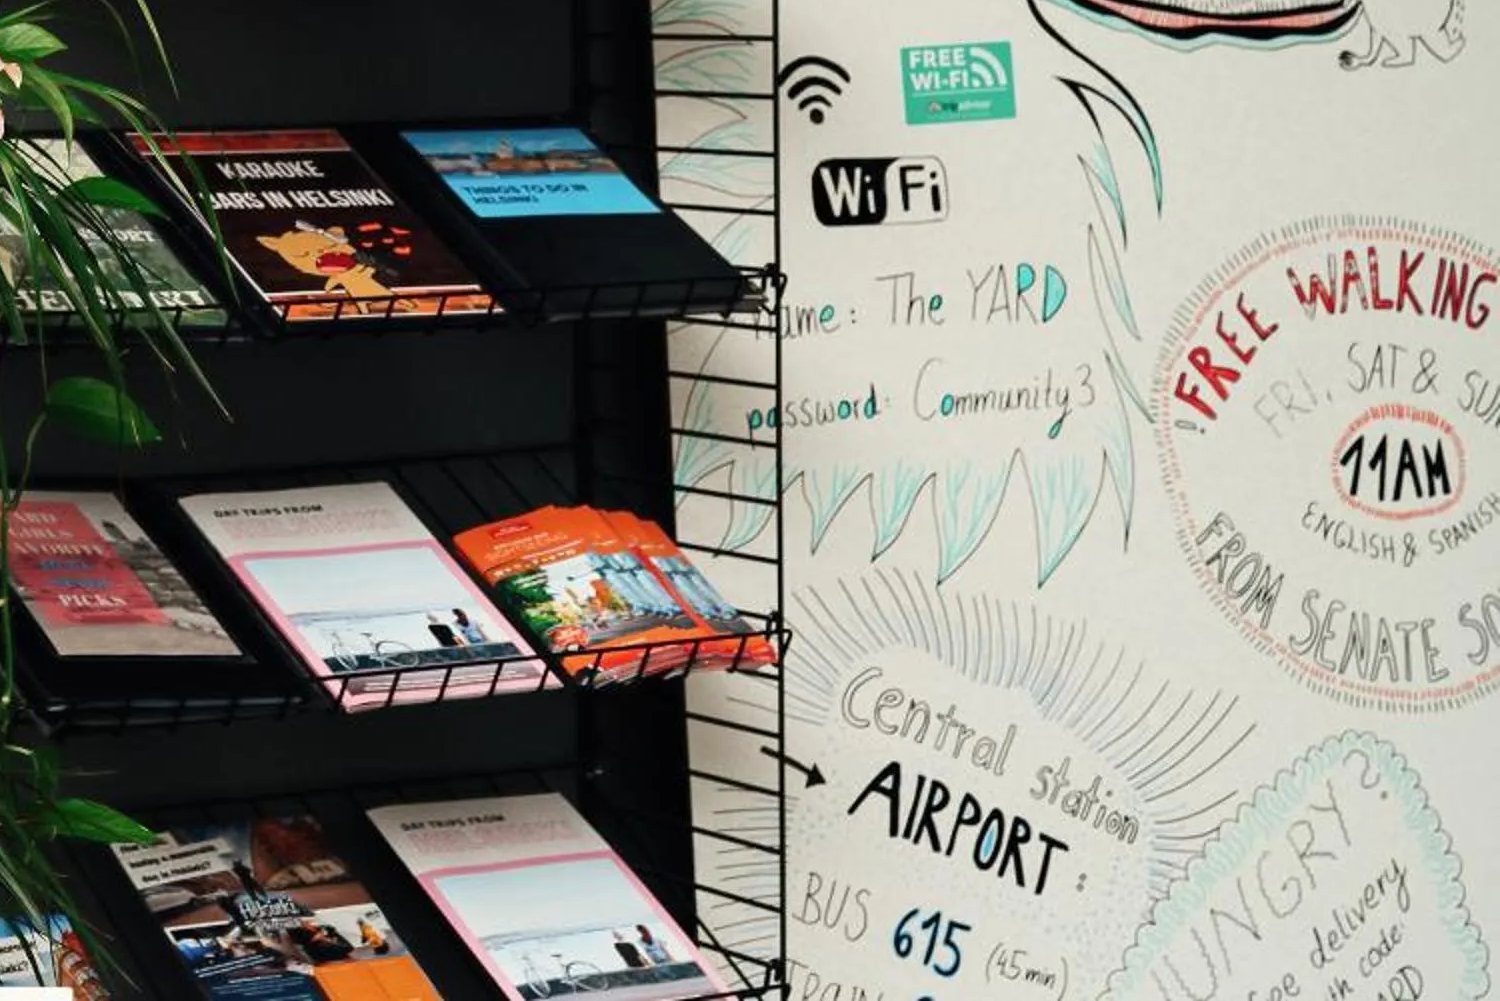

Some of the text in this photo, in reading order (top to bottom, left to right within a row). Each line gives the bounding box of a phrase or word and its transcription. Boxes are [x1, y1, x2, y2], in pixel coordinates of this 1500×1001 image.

[910, 47, 966, 69] FREE
[910, 69, 969, 92] WI-FI
[216, 160, 325, 180] KARAOKE
[260, 190, 287, 209] IN
[288, 188, 395, 207] HELSINKI
[875, 271, 943, 326] The
[965, 262, 1068, 324] YARD
[1175, 246, 1498, 421] FREE WALKING
[1347, 342, 1408, 393] SAT
[1412, 348, 1439, 395] &
[1340, 434, 1452, 502] 11AM
[1302, 500, 1396, 563] ENGLISH
[1195, 512, 1285, 630] FROM
[1289, 589, 1450, 683] SENATE
[840, 666, 1141, 846] Central station
[793, 872, 871, 943] BUS
[893, 907, 972, 977] 615
[1310, 857, 1411, 969] delivery
